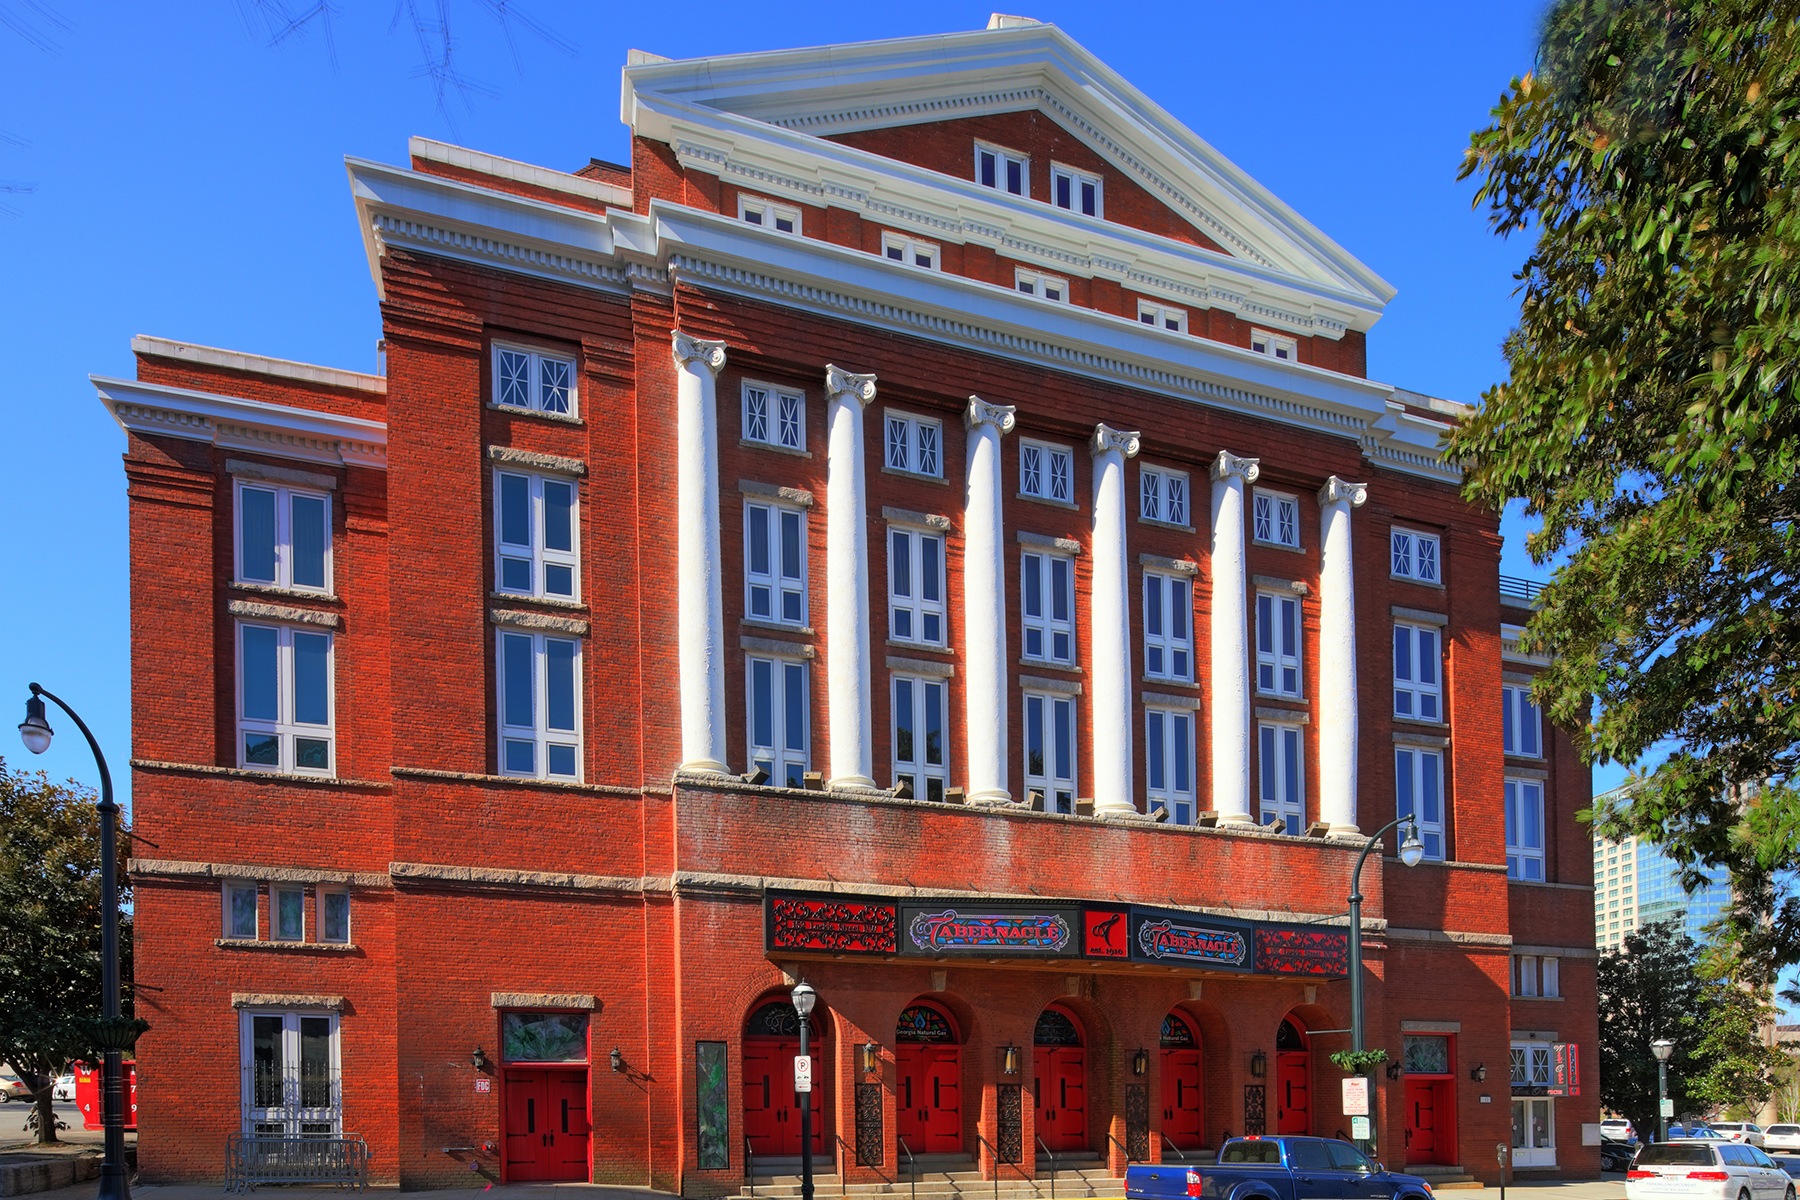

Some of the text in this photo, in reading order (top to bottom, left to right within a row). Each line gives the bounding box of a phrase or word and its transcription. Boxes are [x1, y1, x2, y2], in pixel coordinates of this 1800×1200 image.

[916, 910, 1060, 951] TABERNACLE
[1143, 920, 1239, 957] TABERNACLE
[477, 1081, 490, 1091] FDC
